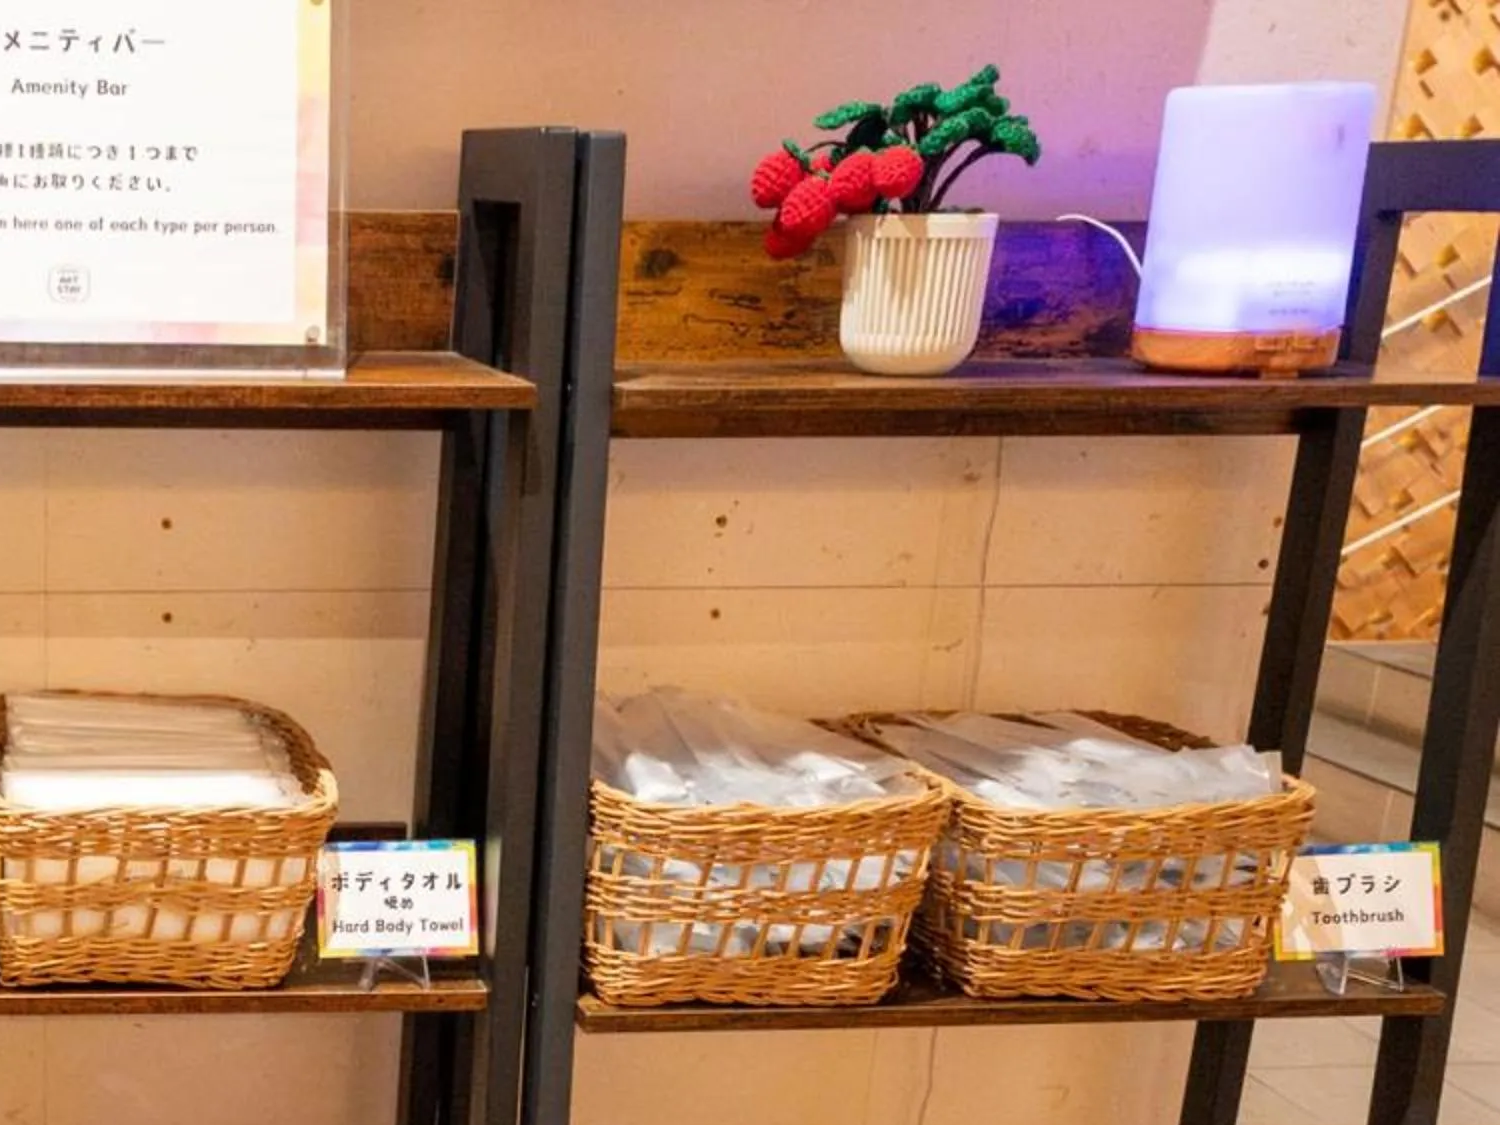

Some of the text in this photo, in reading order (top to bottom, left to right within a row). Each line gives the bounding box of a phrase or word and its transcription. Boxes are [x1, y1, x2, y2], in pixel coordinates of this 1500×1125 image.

[11, 78, 129, 99] Amenity Bar
[13, 214, 48, 230] here
[54, 219, 83, 231] one
[110, 217, 148, 232] each
[153, 219, 187, 235] type
[193, 221, 218, 235] per
[331, 872, 463, 892] ボディタオル
[1312, 873, 1401, 895] 歯ブラシ
[332, 918, 463, 936] Hard Body Towel
[1312, 909, 1404, 925] Toothbrush
